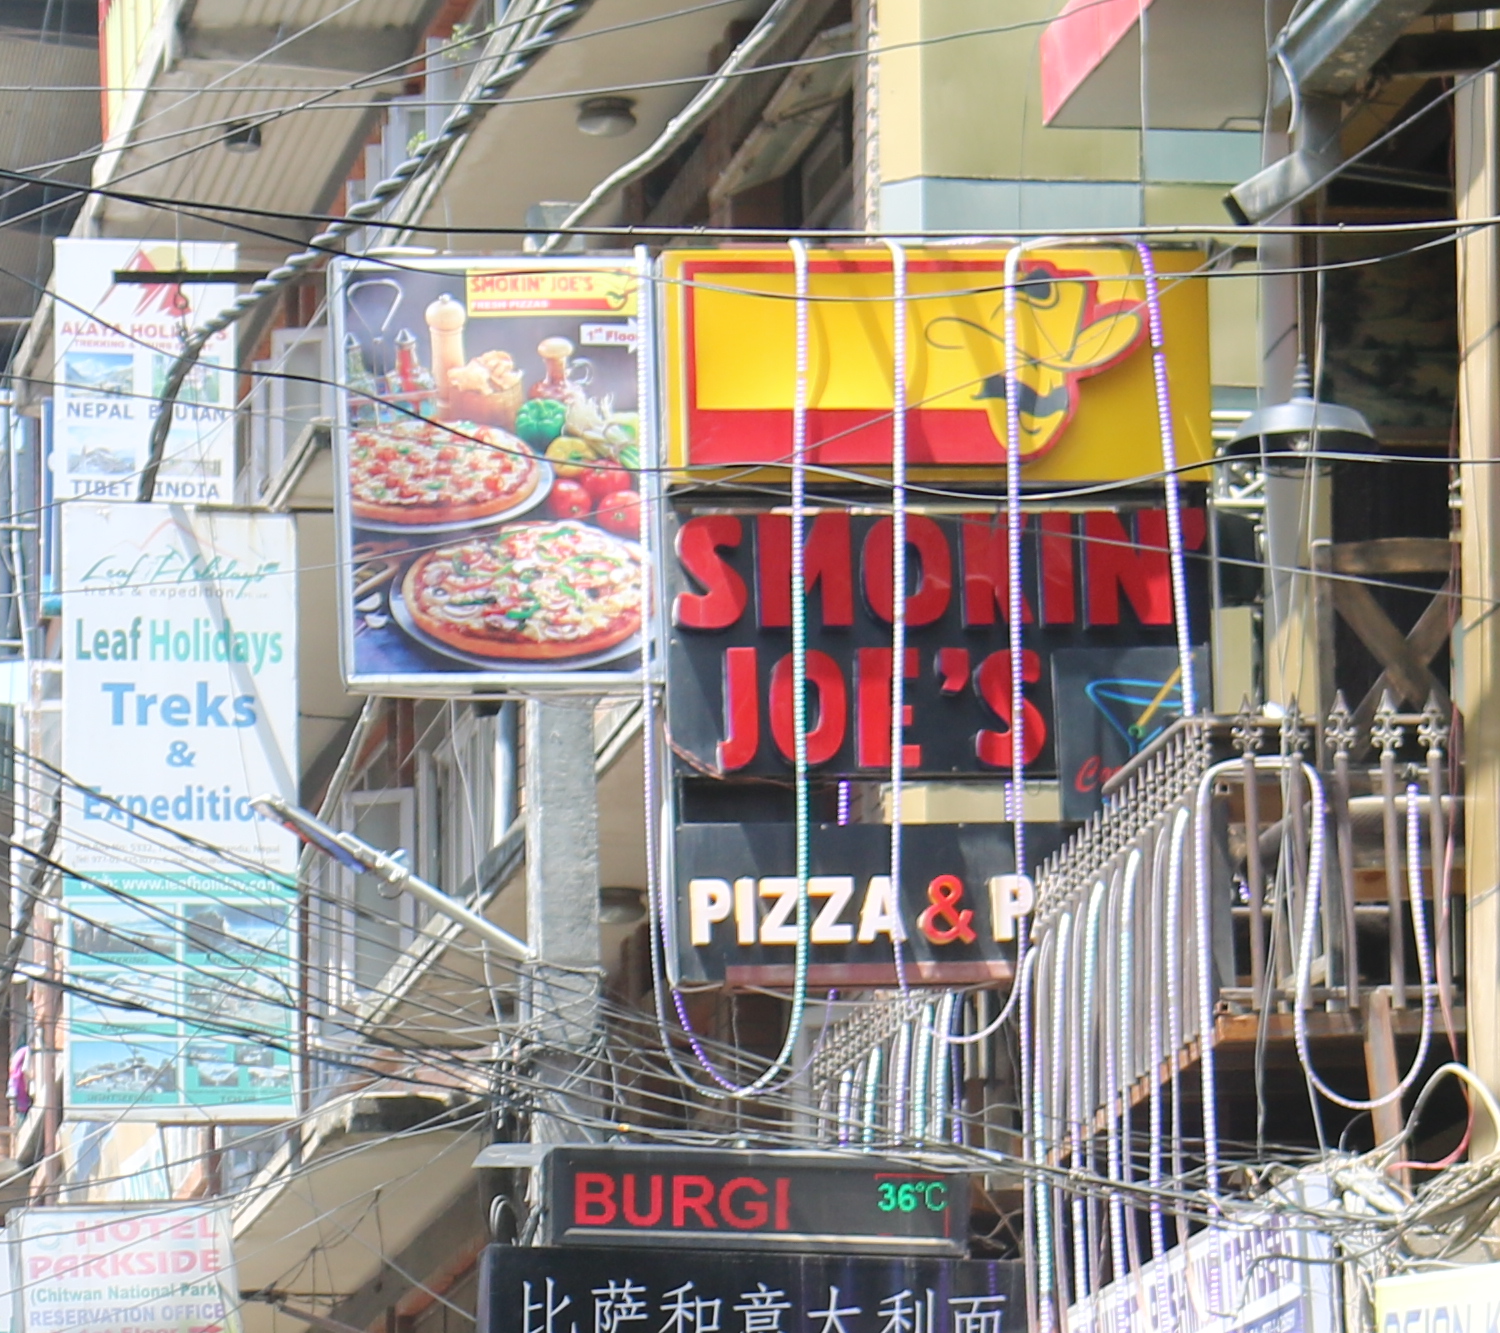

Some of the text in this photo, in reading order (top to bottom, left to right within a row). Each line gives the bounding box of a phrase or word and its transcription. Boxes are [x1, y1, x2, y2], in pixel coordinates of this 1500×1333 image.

[552, 276, 594, 292] JOE'S
[67, 403, 134, 420] NEPAL
[73, 481, 219, 498] TIBET INDIA
[673, 508, 1205, 631] SMOKIN'
[149, 586, 234, 599] expedition
[76, 617, 282, 673] Leaf Holidays
[102, 682, 256, 726] Treks
[717, 645, 1046, 772] JOE'S
[166, 740, 195, 768] &
[689, 874, 975, 946] PIZZA &
[76, 1215, 219, 1246] HOTEL
[29, 1249, 221, 1281] PARKSIDE
[30, 1283, 222, 1305] (Chitwan National Park)
[30, 1302, 225, 1326] RESERVATION OFFICE
